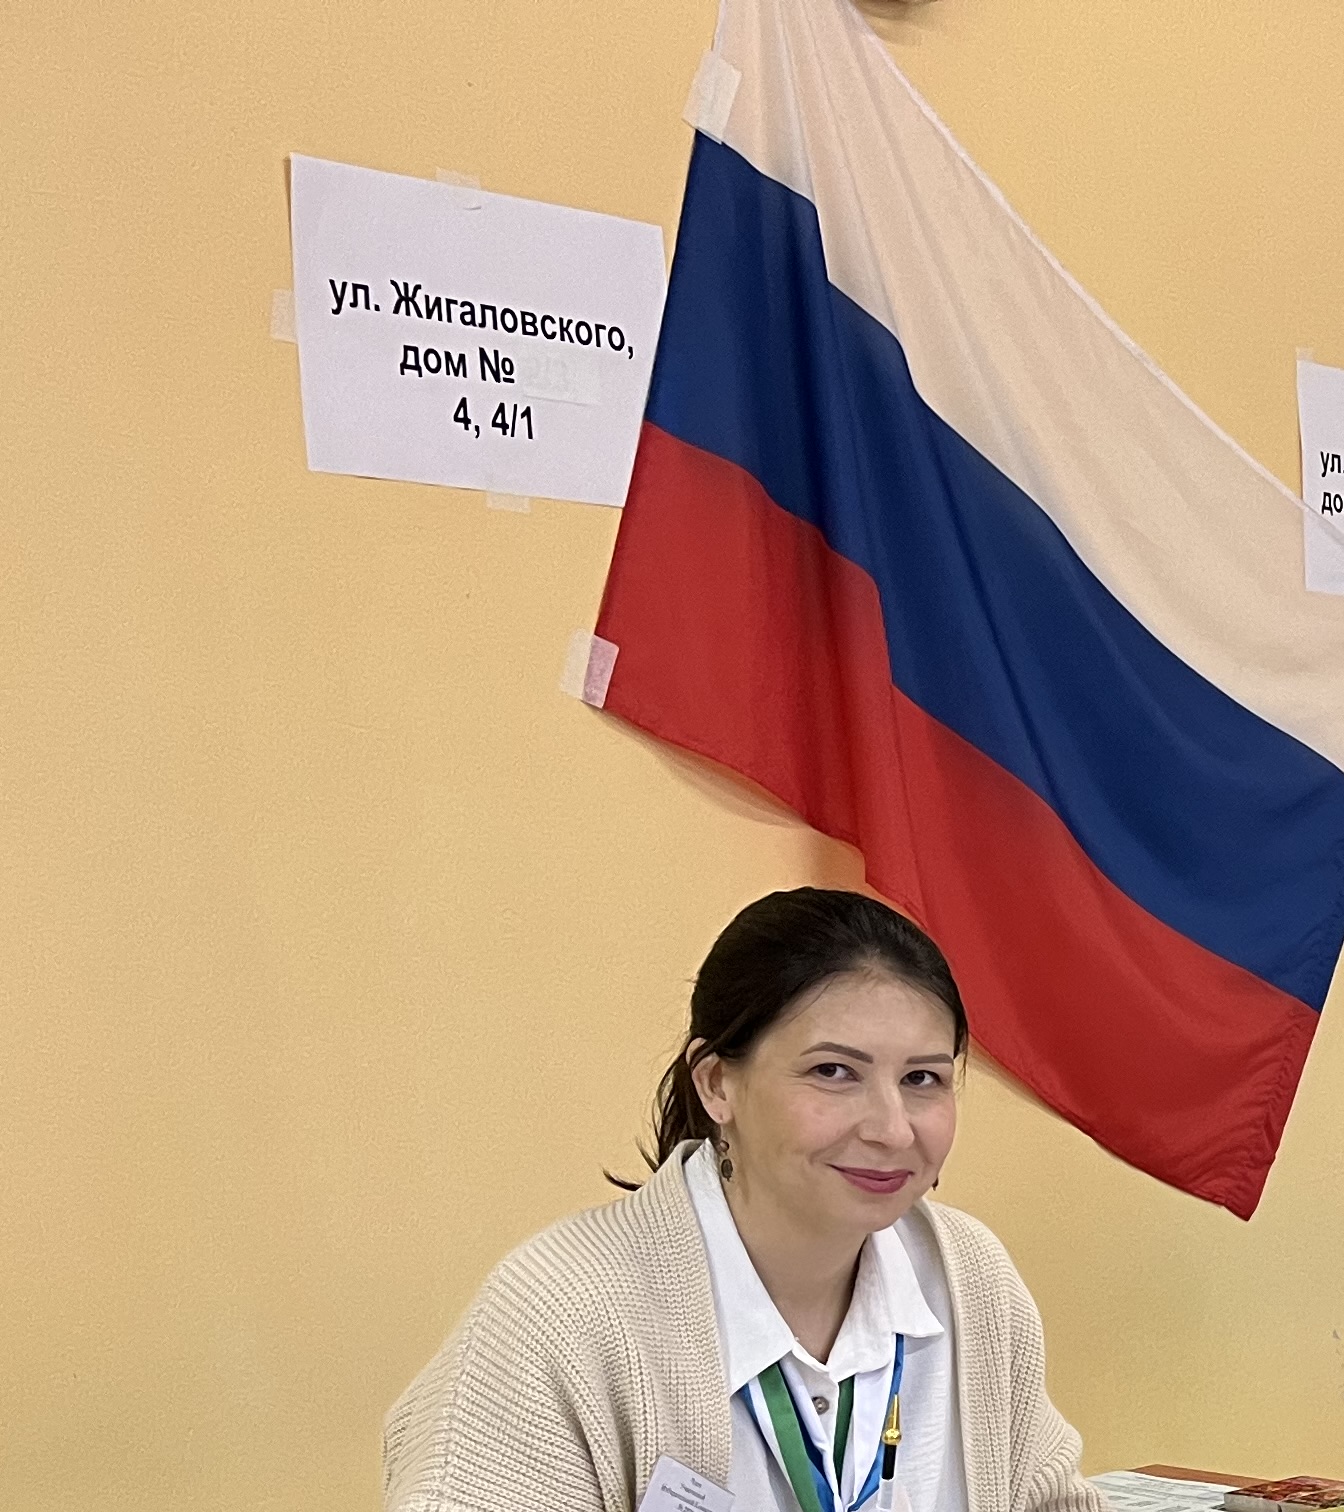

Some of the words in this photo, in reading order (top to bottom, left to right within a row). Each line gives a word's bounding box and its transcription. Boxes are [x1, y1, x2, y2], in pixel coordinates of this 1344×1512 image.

[328, 278, 381, 316] ул.
[389, 279, 635, 360] Жигаловского,
[399, 344, 468, 379] дом
[478, 346, 515, 384] №
[453, 396, 481, 439] 4,
[491, 402, 534, 440] 4/1
